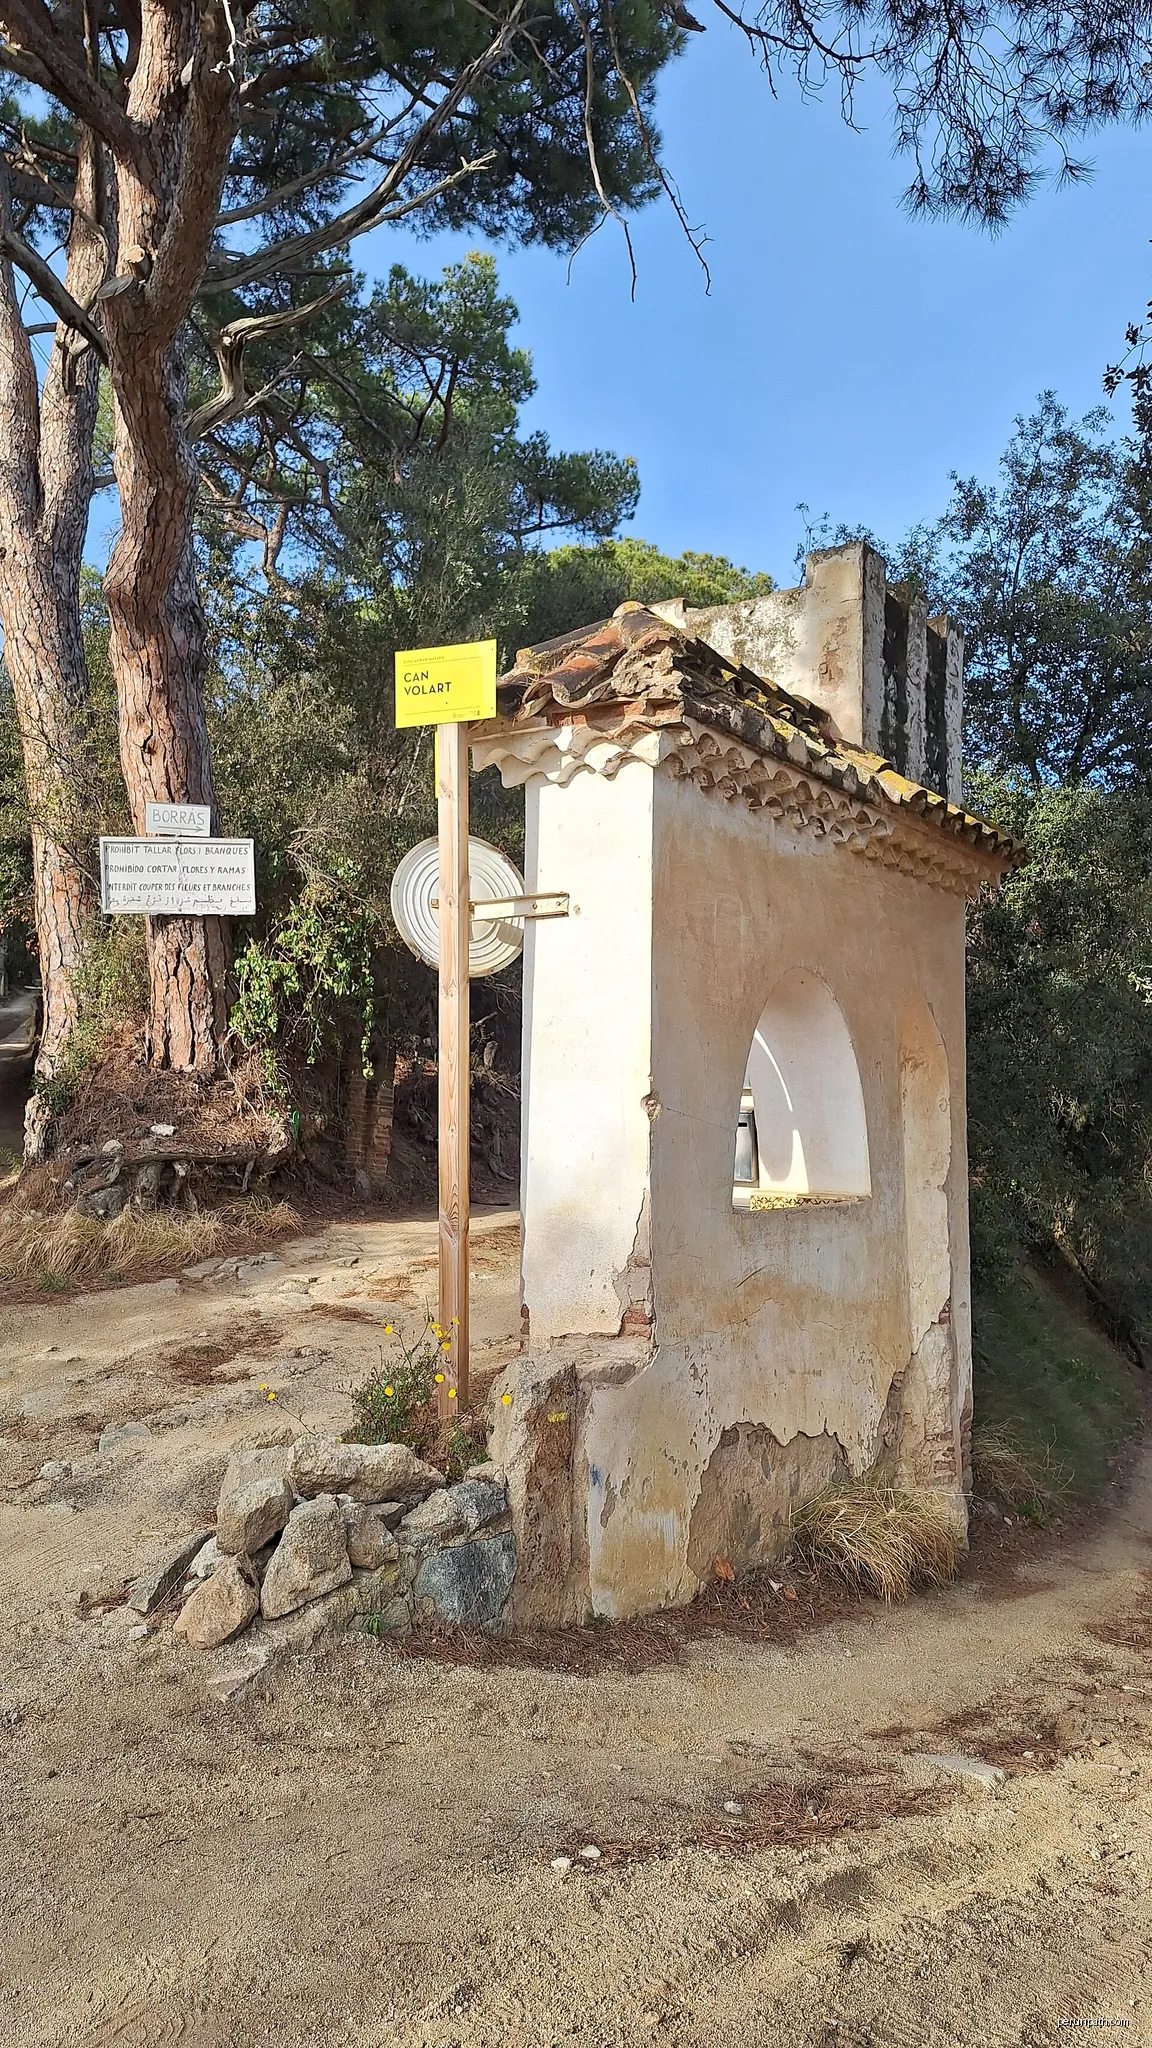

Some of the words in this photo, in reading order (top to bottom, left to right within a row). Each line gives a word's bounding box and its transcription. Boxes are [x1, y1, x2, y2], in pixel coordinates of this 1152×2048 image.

[404, 670, 429, 683] CAN
[404, 682, 452, 696] VOLART
[152, 808, 205, 826] BORRÁS
[105, 844, 140, 855] PROHIBIT
[143, 845, 172, 855] TALLAR
[204, 846, 249, 856] BRANQUES
[105, 863, 144, 874] PROHIBIDO
[146, 864, 177, 874] CORTAR
[182, 865, 208, 875] FLORES
[210, 865, 216, 874] Y
[217, 866, 247, 875] RAMAS
[139, 882, 163, 892] COUPER
[164, 883, 176, 892] DES
[203, 883, 212, 892] ET
[212, 884, 251, 893] BRANCHES
